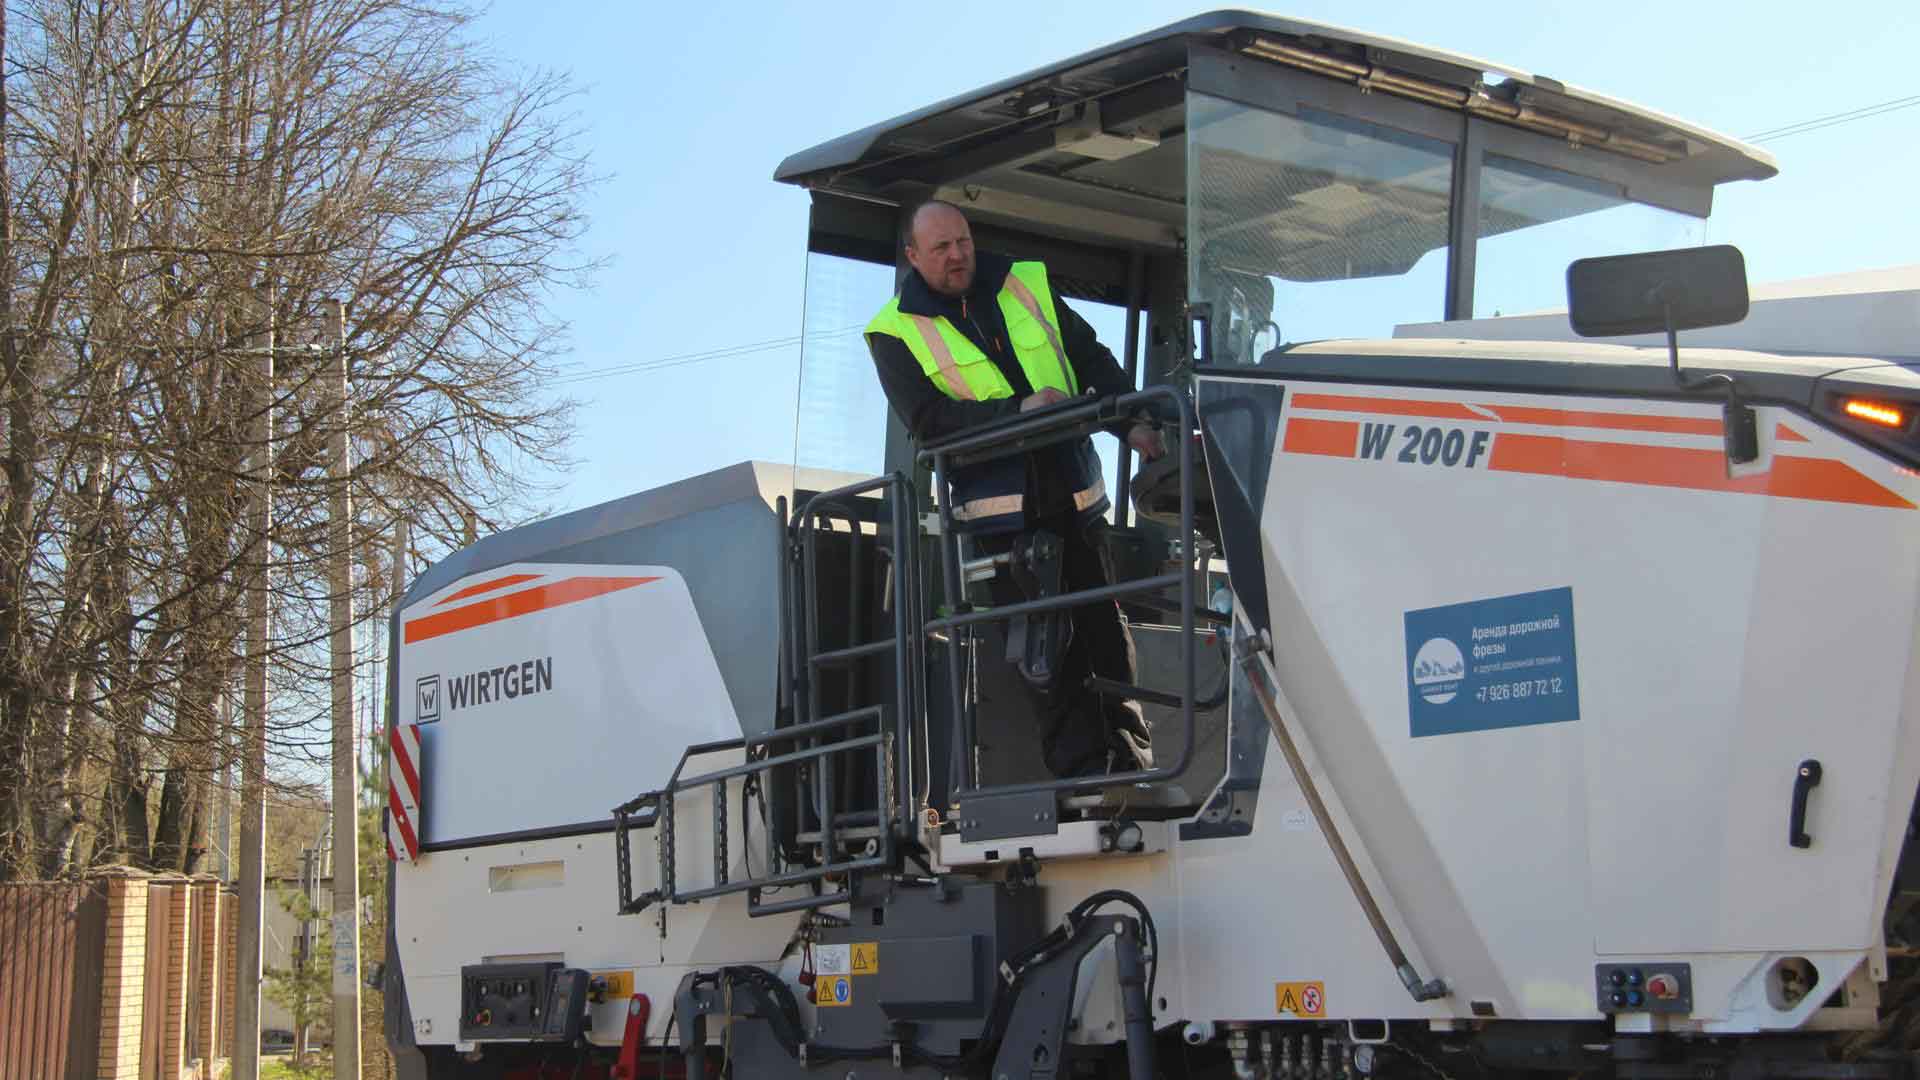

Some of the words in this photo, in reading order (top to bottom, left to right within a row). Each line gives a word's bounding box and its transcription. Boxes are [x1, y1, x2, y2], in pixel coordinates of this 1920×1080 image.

[1360, 422, 1396, 460] W
[1472, 626, 1507, 641] Аренда
[1509, 614, 1560, 635] дорожной
[1472, 643, 1506, 659] фрезы
[448, 656, 552, 710] WIRTGEN
[1476, 687, 1488, 702] +7
[1489, 684, 1510, 701] 926
[1513, 681, 1533, 698] 887
[1535, 679, 1548, 695] 72
[1551, 677, 1563, 693] 12
